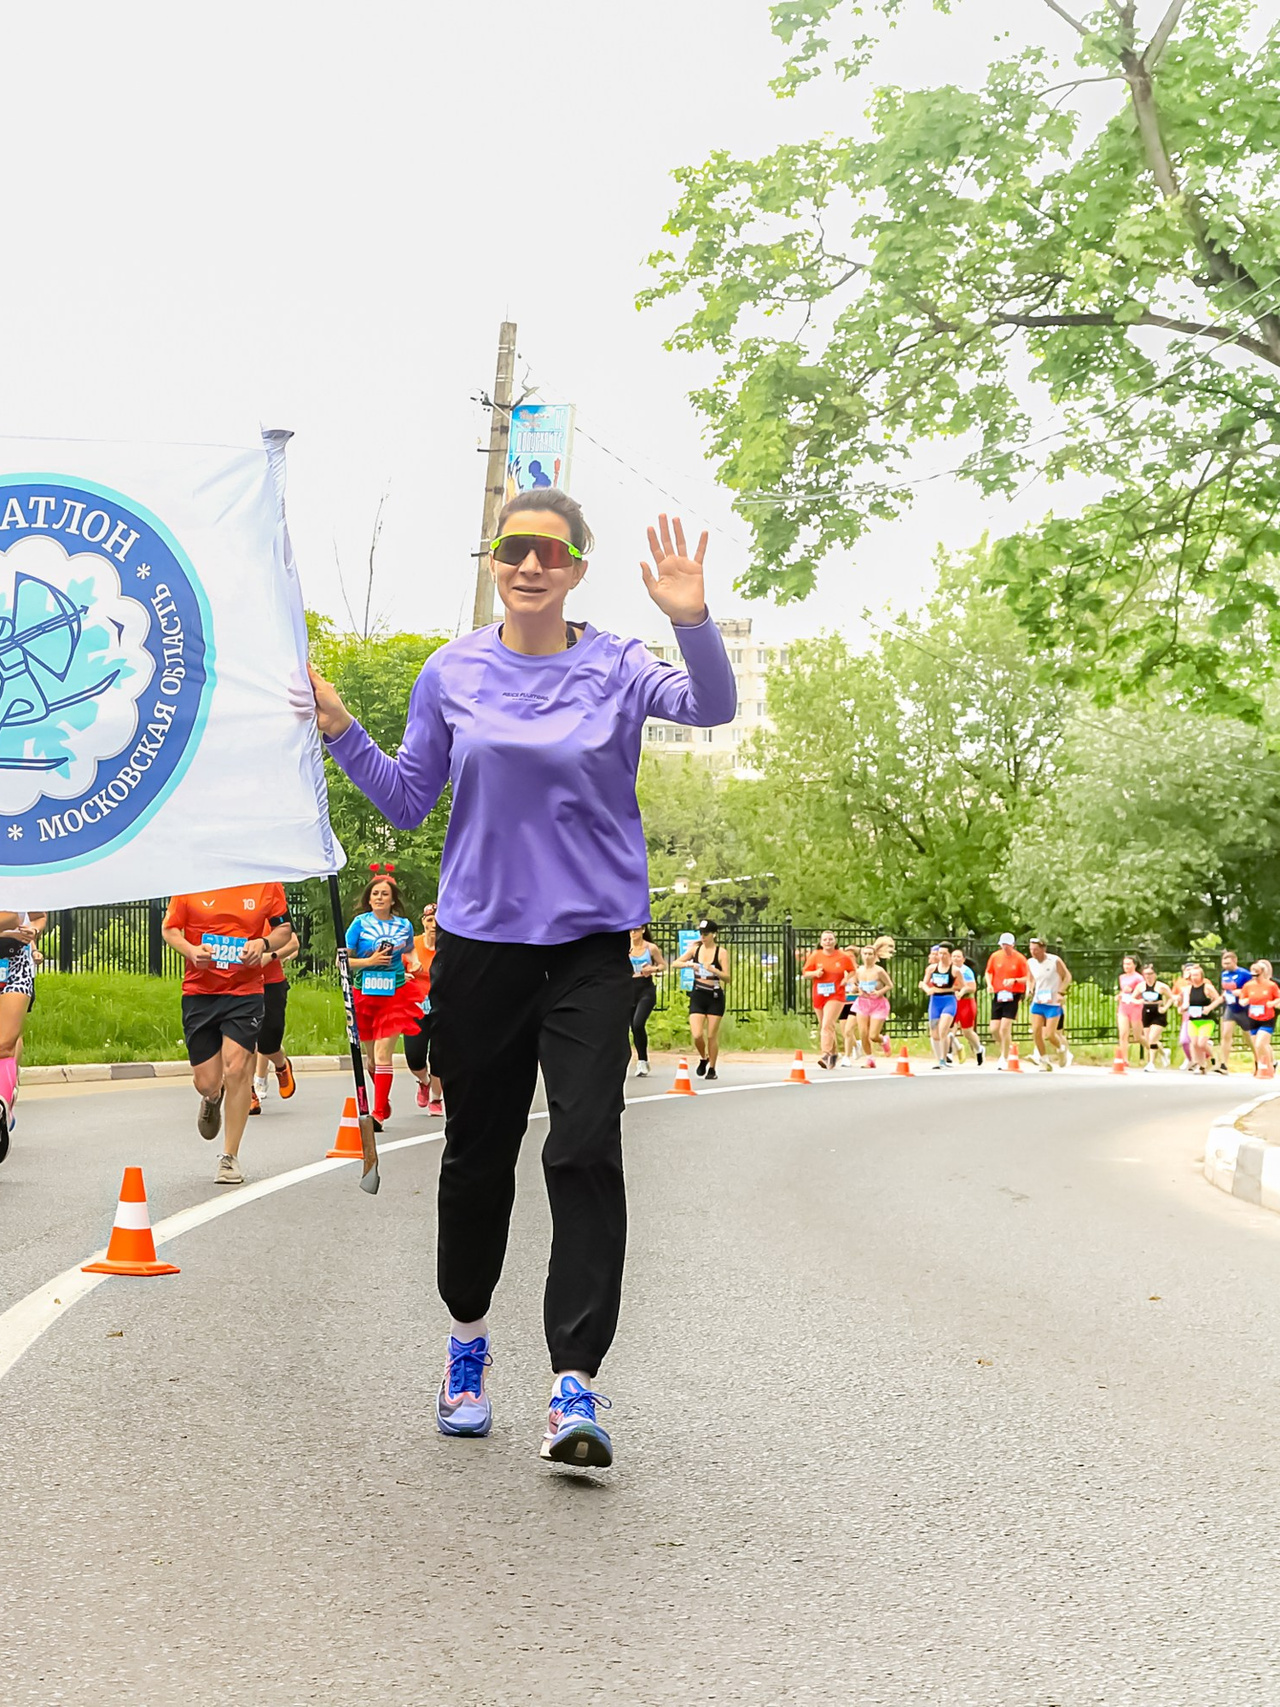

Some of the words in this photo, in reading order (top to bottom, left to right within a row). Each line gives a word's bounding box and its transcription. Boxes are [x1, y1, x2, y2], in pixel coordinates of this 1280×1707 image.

[38, 701, 178, 843] МОСКОВСКАЯ
[149, 582, 187, 694] ОБЛАСТЬ
[243, 898, 256, 911] 10
[365, 977, 394, 991] 90001
